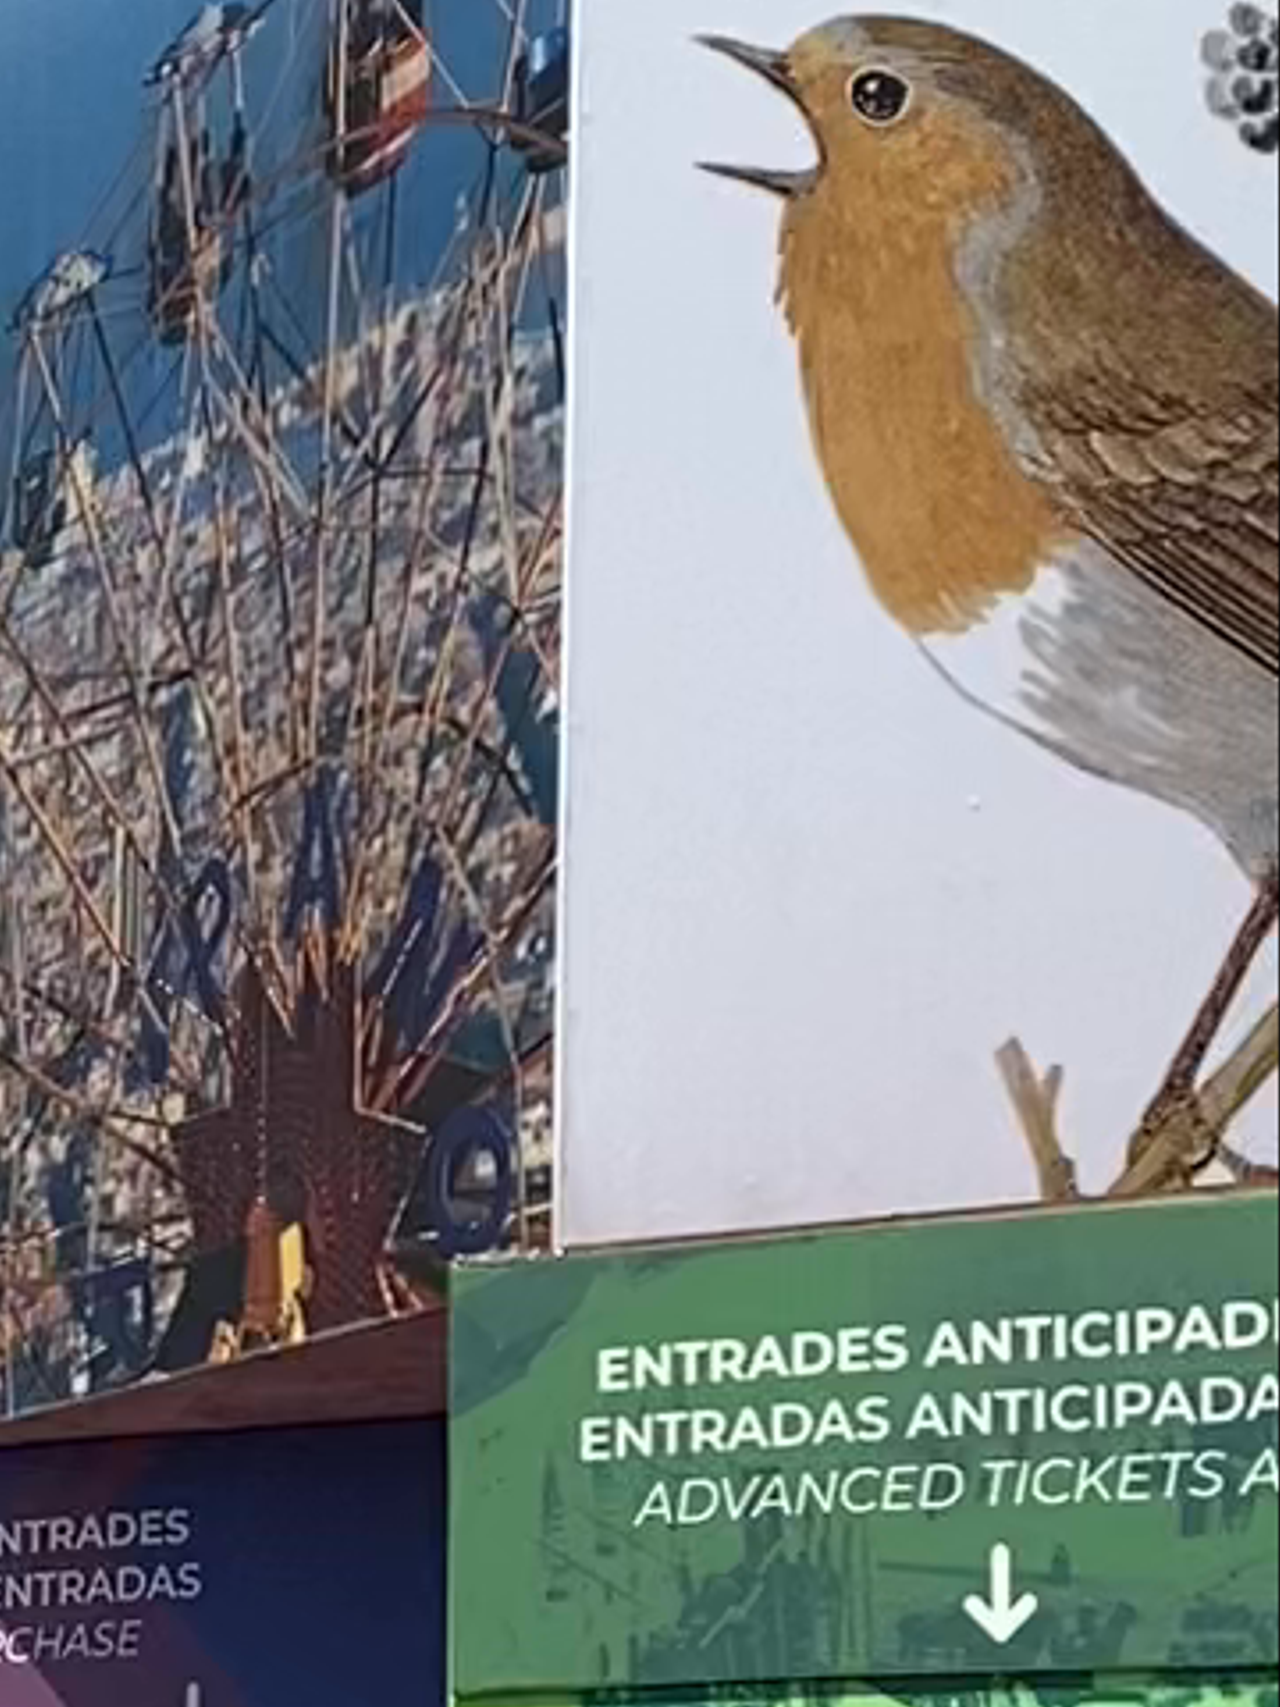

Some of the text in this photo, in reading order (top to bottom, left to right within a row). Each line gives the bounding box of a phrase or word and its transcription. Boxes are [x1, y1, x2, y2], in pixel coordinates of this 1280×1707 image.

[597, 1299, 1279, 1392] ENTRADES ANTICIPAD
[579, 1374, 1279, 1462] ENTRADAS ANTICIPADA
[633, 1462, 965, 1527] ADVANCED
[982, 1450, 1227, 1506] TICKETS
